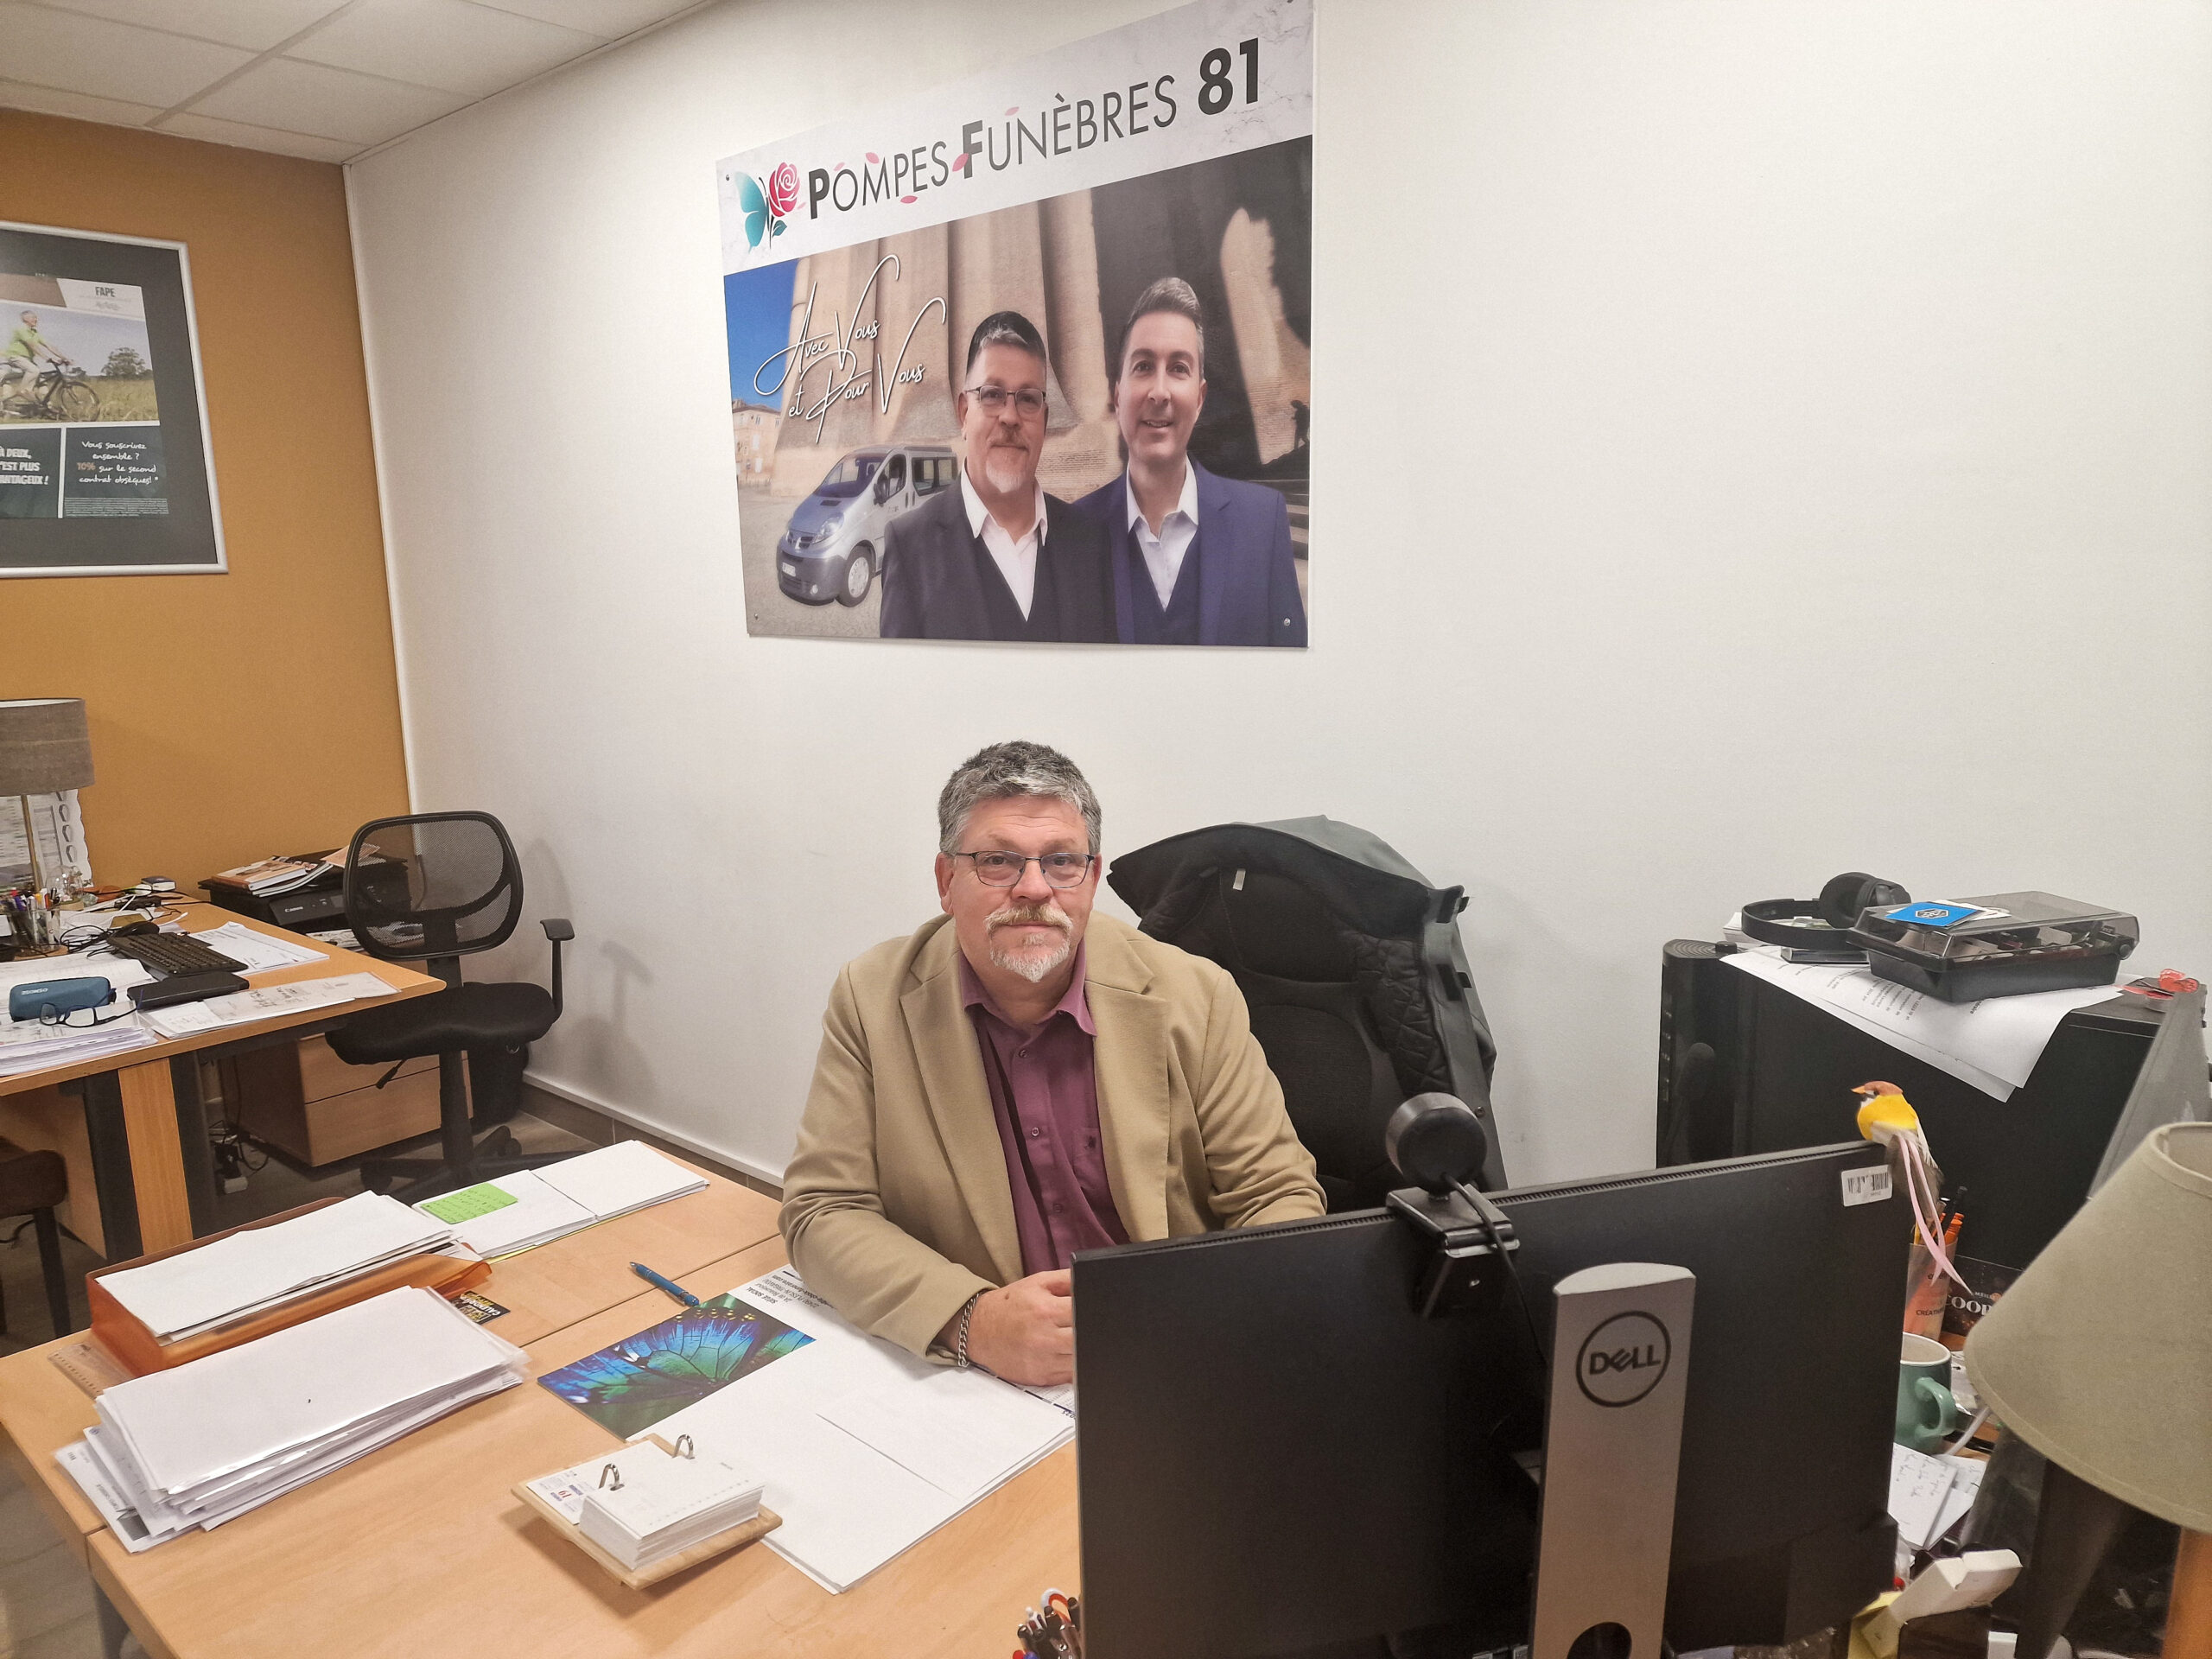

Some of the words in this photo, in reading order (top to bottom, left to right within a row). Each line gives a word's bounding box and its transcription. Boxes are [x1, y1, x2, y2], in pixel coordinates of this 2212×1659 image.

[807, 139, 950, 220] POMPES
[960, 73, 1178, 180] FUNÈBRES
[1196, 36, 1261, 116] 81
[94, 286, 117, 298] FAPE
[753, 280, 834, 396] Avec
[834, 252, 901, 371] Vous
[788, 384, 804, 418] et
[798, 348, 873, 444] Pour
[877, 296, 947, 415] Vous
[81, 441, 104, 449] Vous
[105, 442, 148, 450] souscrivez
[92, 452, 133, 461] ensemble
[19, 461, 41, 472] PLUS
[128, 464, 156, 474] second
[79, 474, 112, 483] contrat
[1589, 1344, 1662, 1376] DELL
